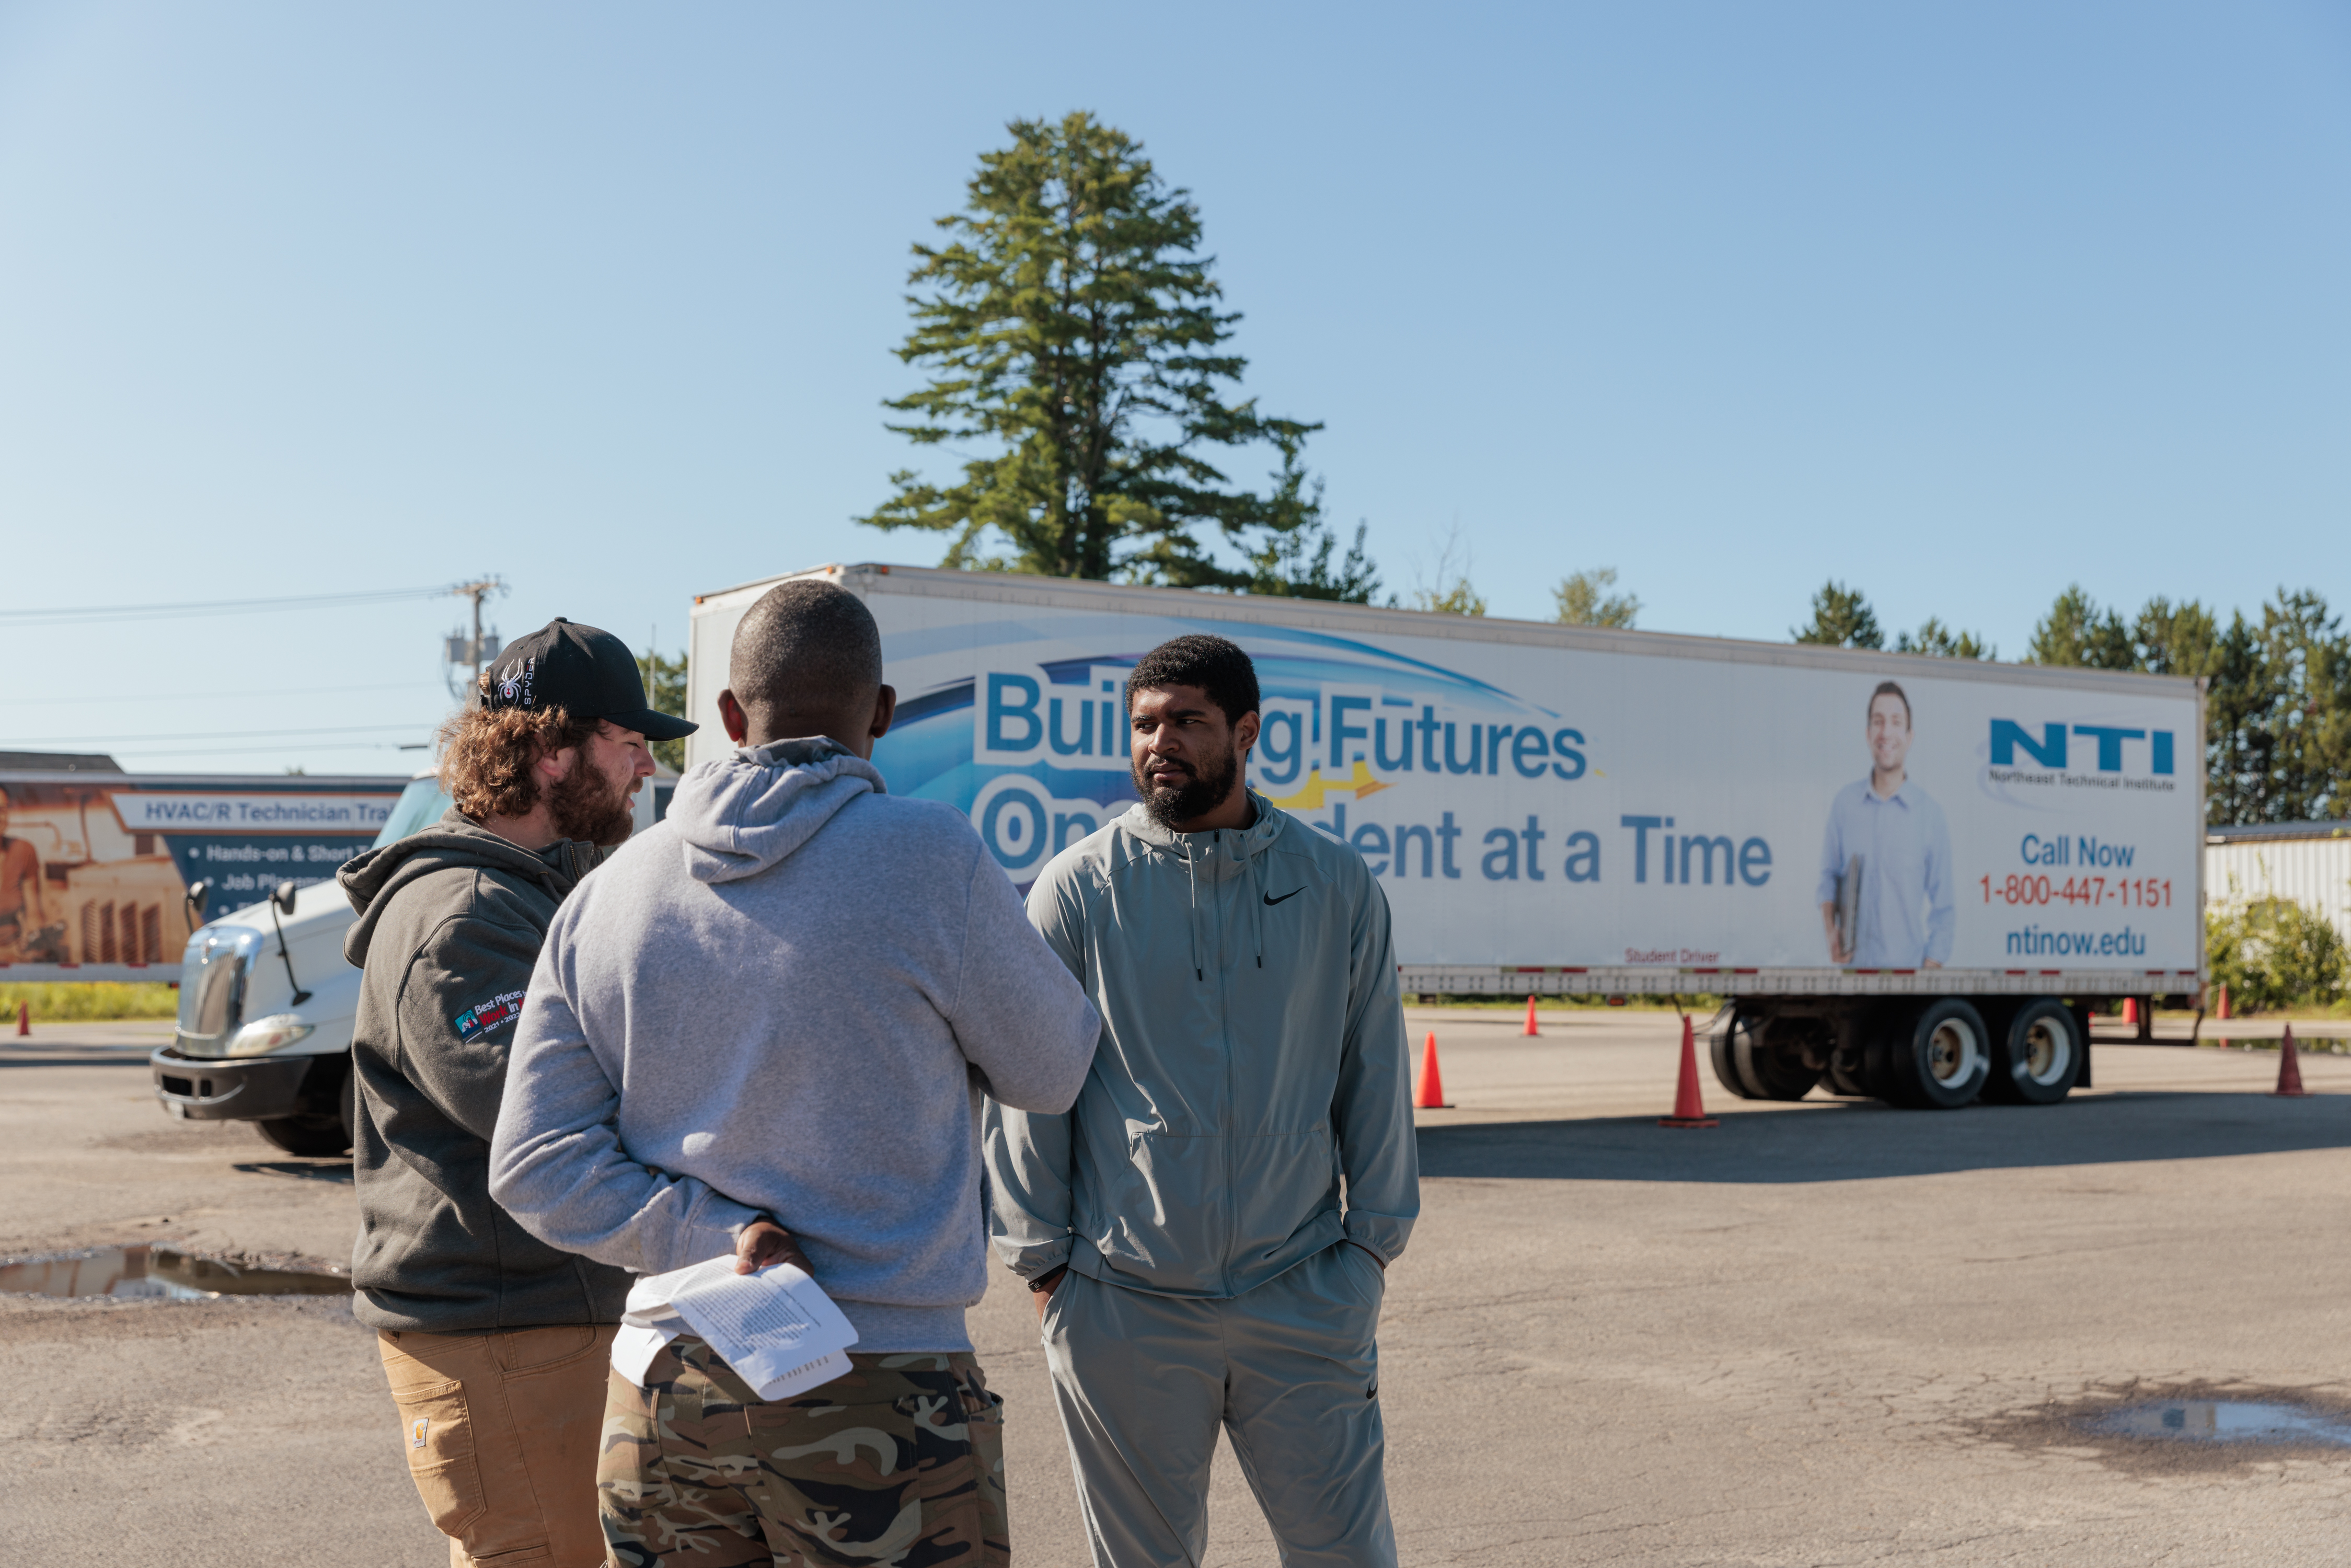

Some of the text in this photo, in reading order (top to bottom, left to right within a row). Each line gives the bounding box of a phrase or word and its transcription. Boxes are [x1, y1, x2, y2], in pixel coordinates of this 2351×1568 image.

[524, 657, 535, 705] SPYDER
[1329, 695, 1586, 780] Futures
[1989, 718, 2174, 775] NTI
[1989, 769, 2176, 792] Northeast Technical Institute
[146, 802, 231, 821] HVAC/R
[237, 802, 350, 821] Technician
[206, 844, 289, 862] Hands-on
[291, 845, 305, 862] &
[307, 845, 354, 862] Short
[1481, 814, 1546, 881] at
[1564, 829, 1601, 883] a
[1621, 814, 1772, 886] Time
[2021, 834, 2135, 868] Call Now
[222, 873, 255, 890] Job
[1979, 872, 2172, 908] 1-800-447-1151
[2007, 924, 2146, 955] ntinow.edu
[1624, 947, 1720, 964] Student Driver
[475, 1000, 495, 1015] Best
[494, 990, 522, 1006] Places
[479, 1005, 508, 1026] Work
[507, 1002, 519, 1013] in
[484, 1021, 500, 1033] 2021
